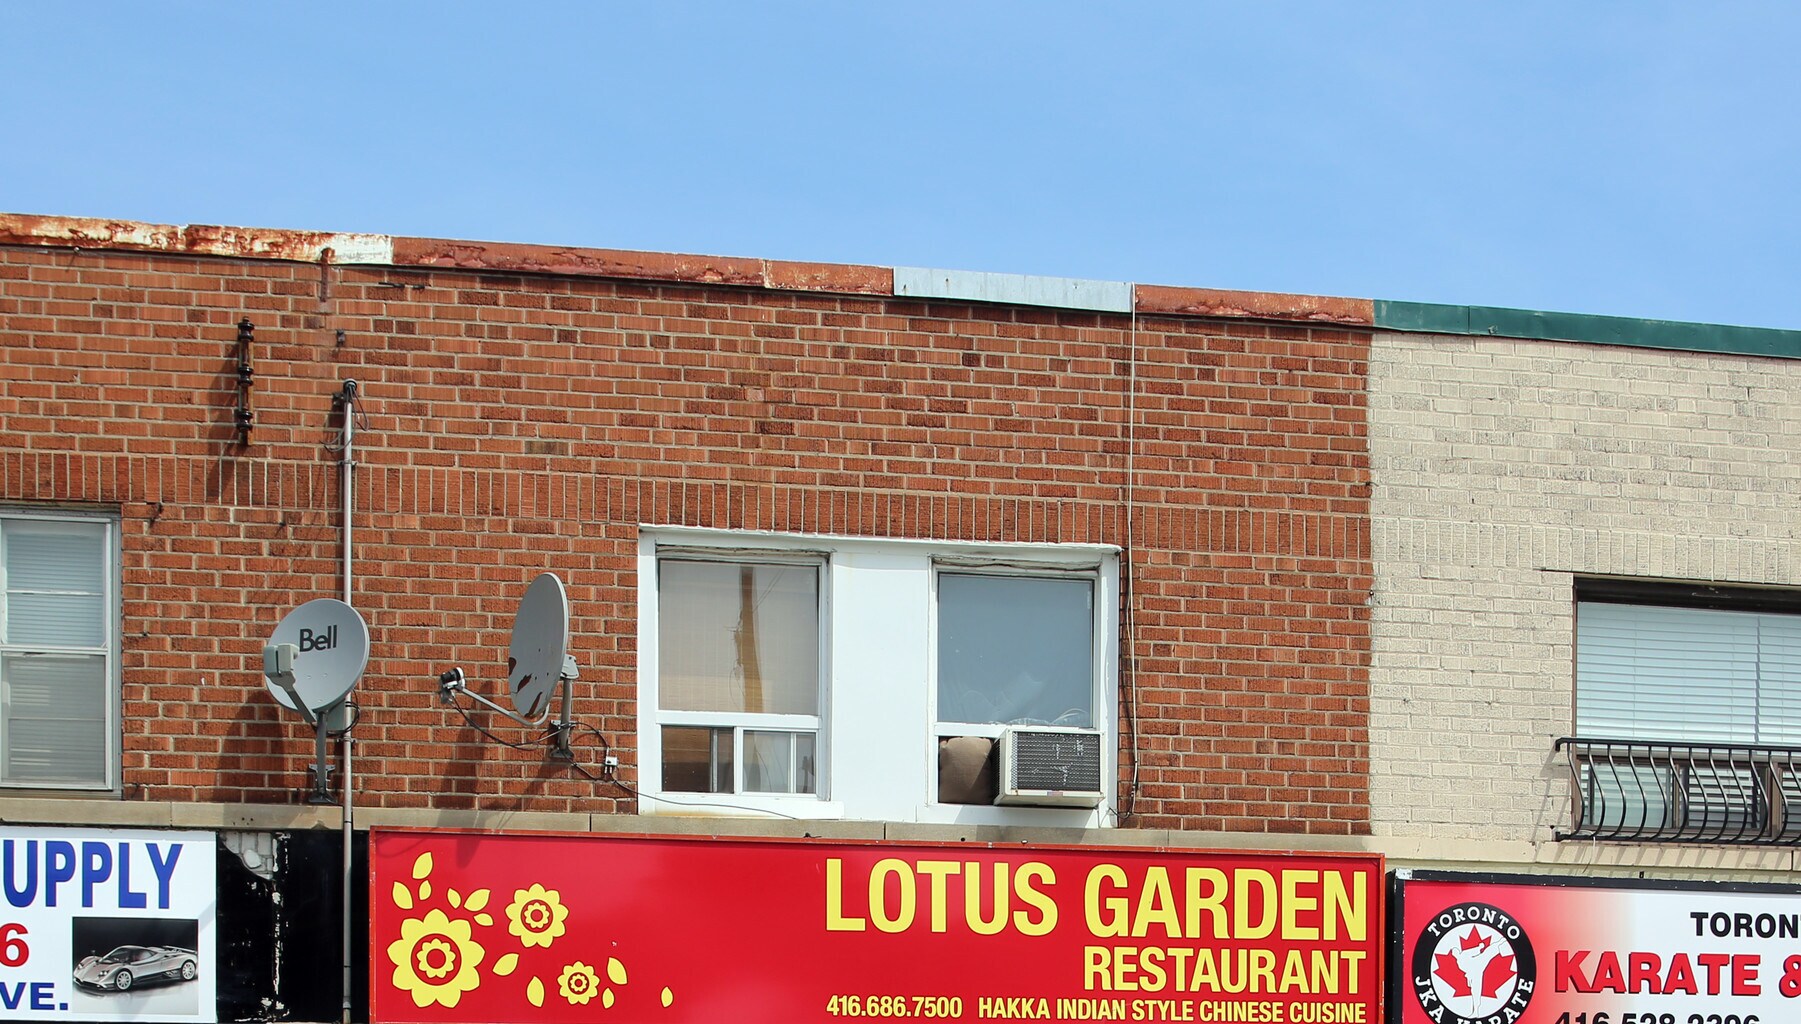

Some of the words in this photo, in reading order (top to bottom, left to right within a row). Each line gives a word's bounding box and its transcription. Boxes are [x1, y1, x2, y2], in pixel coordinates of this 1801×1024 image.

[300, 625, 337, 652] Bell
[3, 840, 183, 909] UPPLY
[825, 858, 1059, 936] LOTUS
[1084, 863, 1367, 941] GARDEN
[1428, 906, 1520, 939] TORONTO
[1690, 912, 1801, 938] TORON
[0, 923, 29, 967] 6
[1083, 946, 1367, 994] RESTAURANT
[1555, 950, 1761, 996] KARATE
[1779, 954, 1801, 998] &
[0, 982, 68, 1010] VE.
[826, 996, 962, 1018] 416.686.7500
[978, 997, 1050, 1020] HAKKA
[1056, 999, 1126, 1021] INDIAN
[1132, 999, 1193, 1022] STYLE
[1199, 1001, 1284, 1023] CHINESE
[1289, 1002, 1367, 1024] CUISINE
[1415, 976, 1445, 1023] JKA
